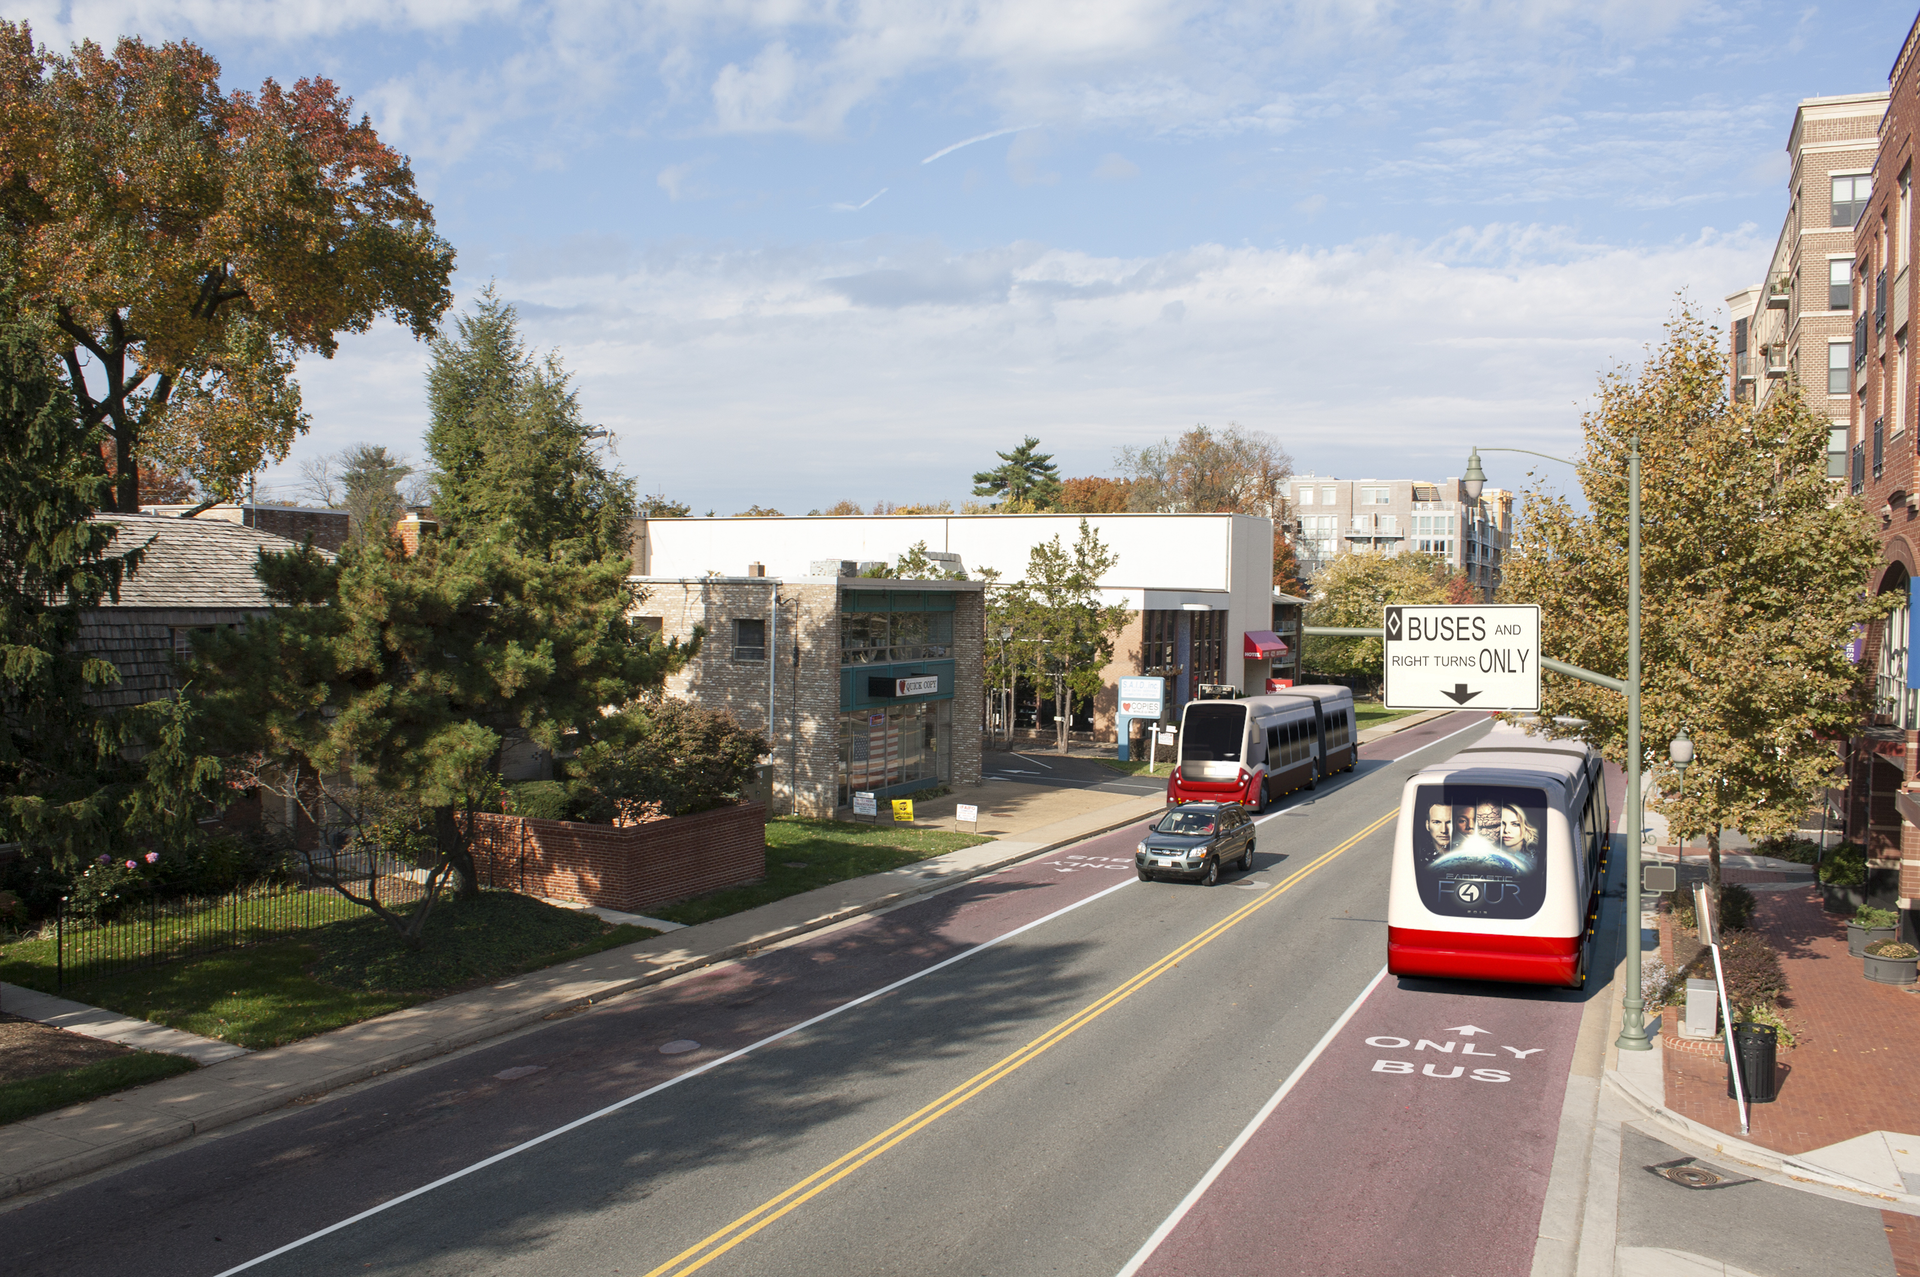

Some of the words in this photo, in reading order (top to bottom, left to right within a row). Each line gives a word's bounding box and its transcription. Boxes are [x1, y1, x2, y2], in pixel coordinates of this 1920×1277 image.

[1408, 616, 1486, 641] BUSES
[1495, 624, 1522, 635] AND
[1392, 655, 1429, 667] RIGHT
[1433, 656, 1476, 667] TURNS
[1479, 648, 1530, 673] ONLY
[906, 681, 922, 692] QUICK
[923, 680, 937, 689] COPY
[1131, 702, 1159, 711] COPIES
[1041, 860, 1130, 870] ONLY
[1066, 854, 1134, 863] BUS
[1364, 1035, 1546, 1060] ONLY
[1370, 1059, 1512, 1083] BUS
